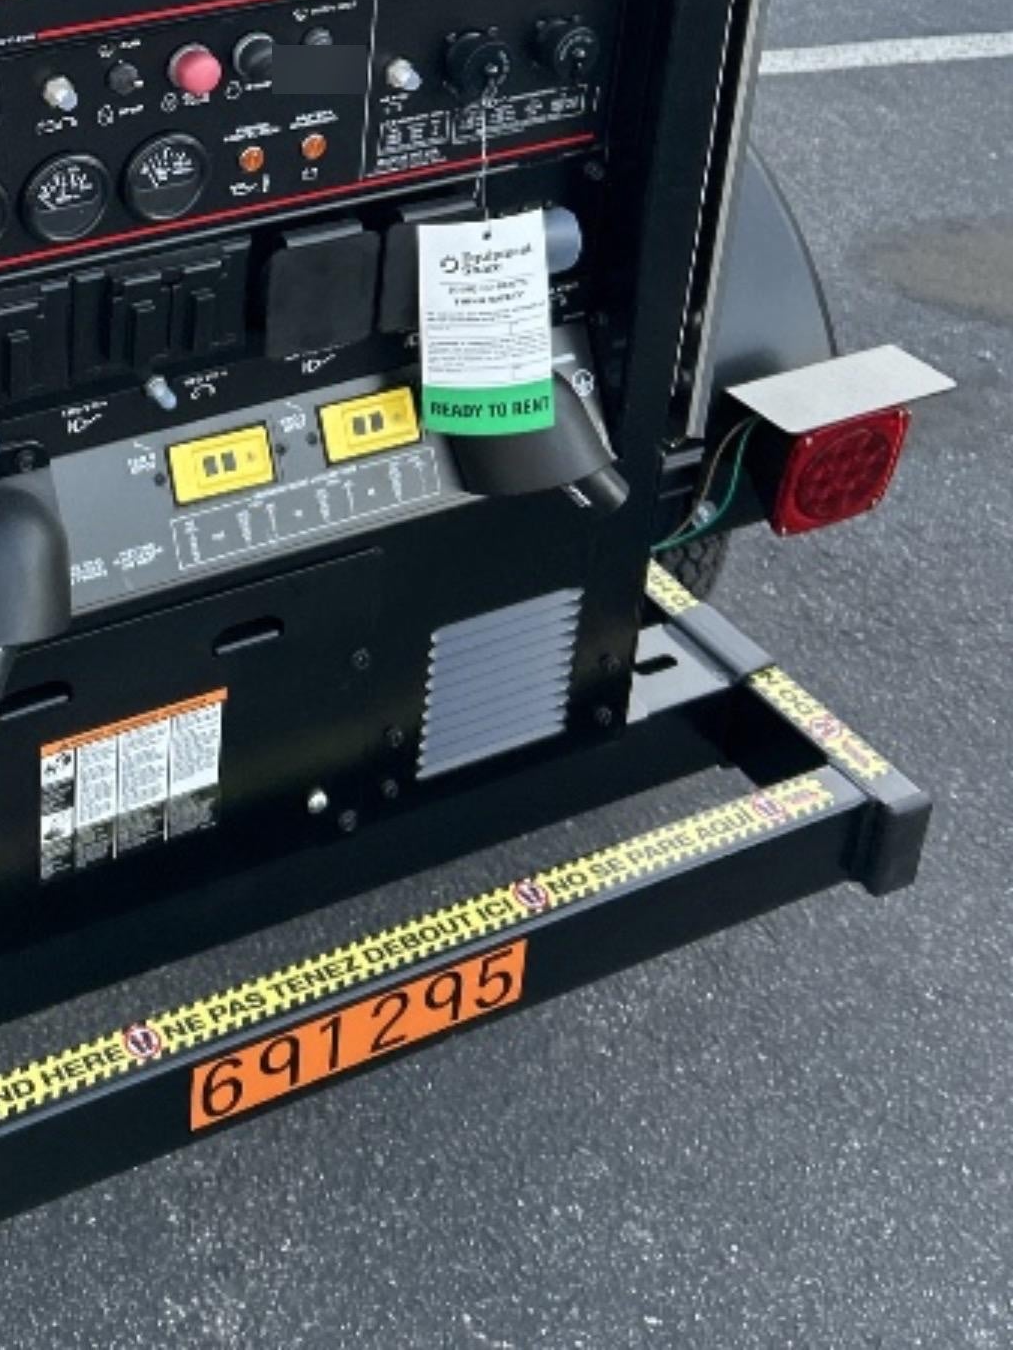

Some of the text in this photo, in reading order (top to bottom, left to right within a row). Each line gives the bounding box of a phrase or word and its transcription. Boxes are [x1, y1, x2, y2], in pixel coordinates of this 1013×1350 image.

[430, 395, 550, 419] READY TO RENT
[547, 871, 588, 894] NO
[589, 857, 628, 878] SE
[629, 830, 692, 866] PARE
[164, 897, 514, 1043] NE PAS TENEZ DEBOUT ICI
[201, 946, 515, 1117] 691295
[42, 1043, 127, 1088] HERE
